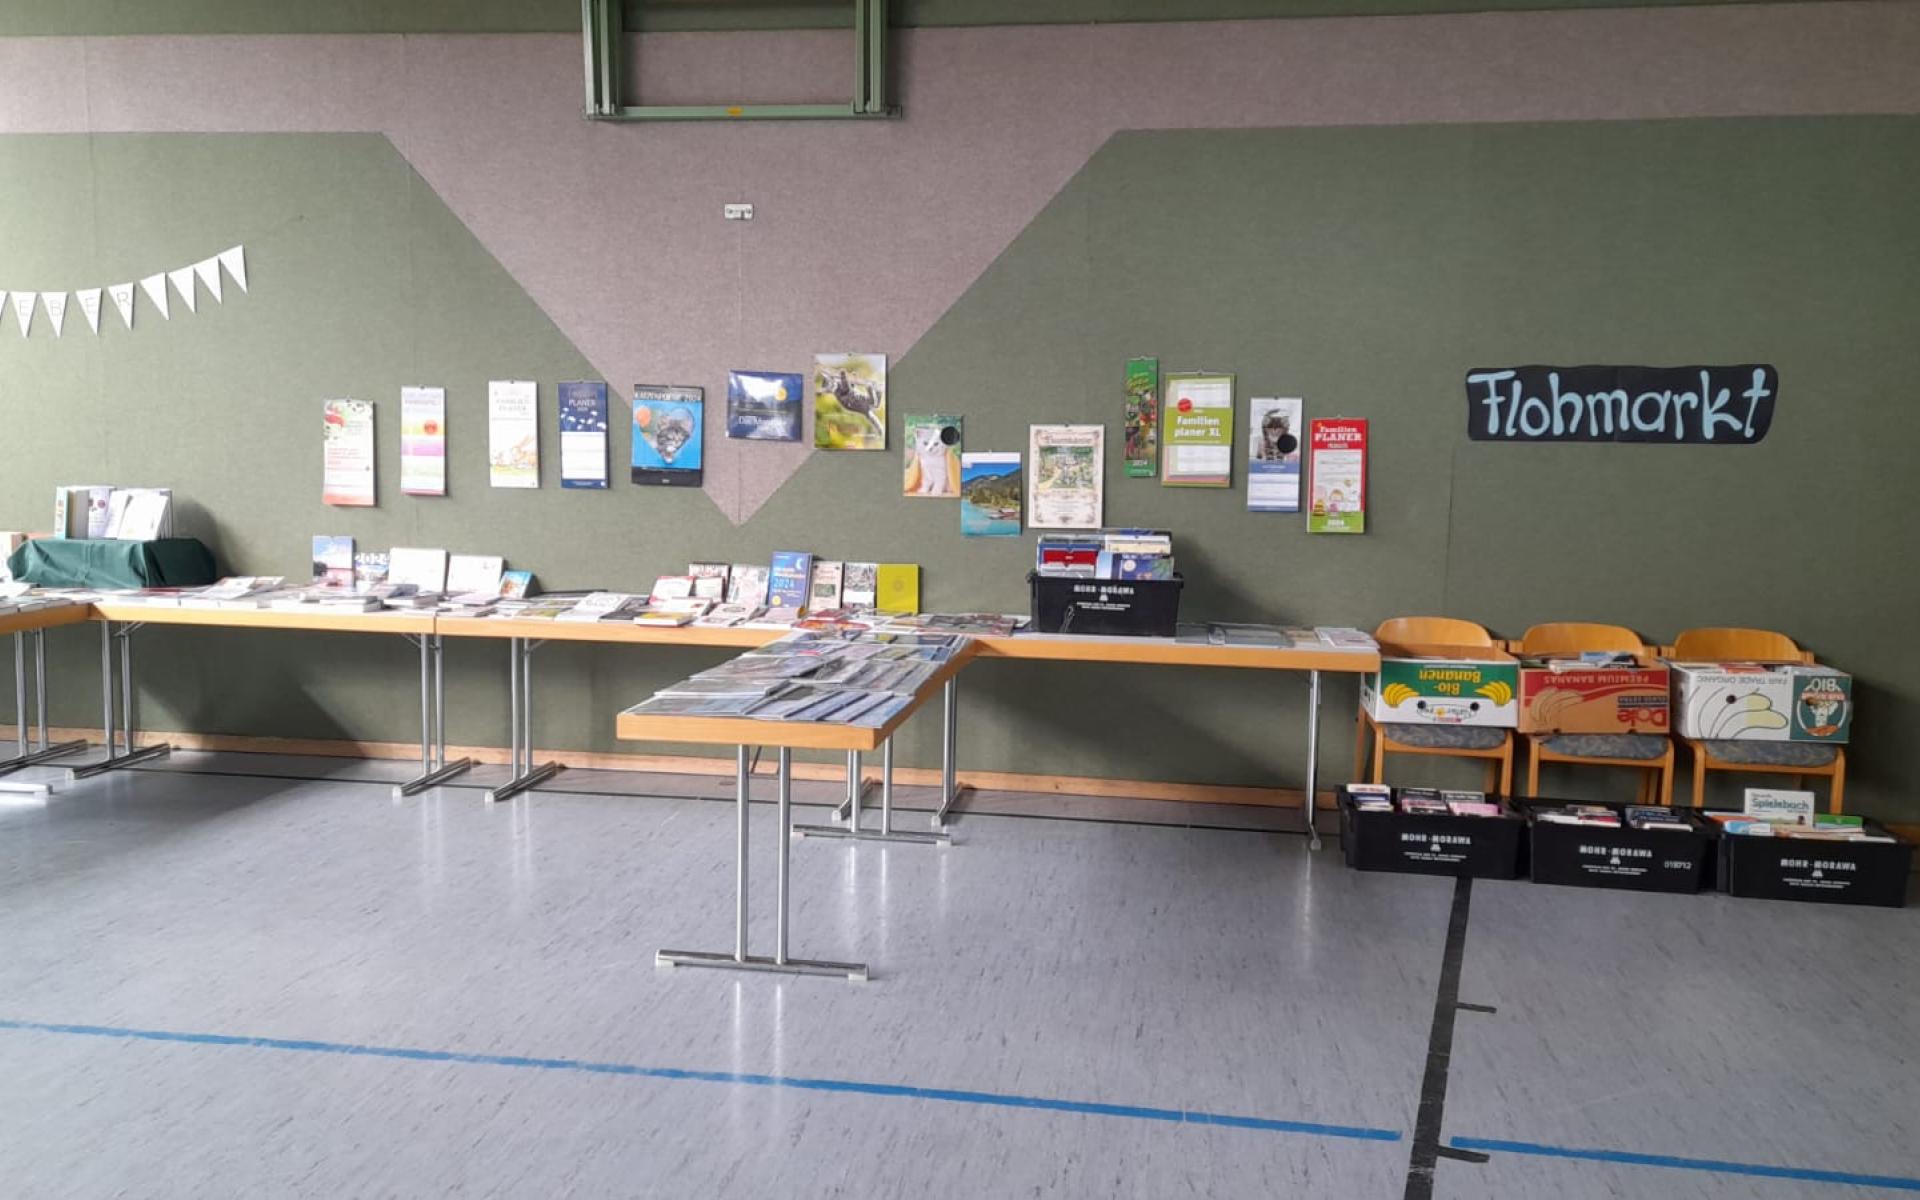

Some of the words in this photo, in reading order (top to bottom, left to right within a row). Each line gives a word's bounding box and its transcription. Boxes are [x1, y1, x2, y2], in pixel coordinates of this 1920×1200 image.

[568, 399, 596, 407] PLANER
[1467, 367, 1771, 440] Flohmarkt
[1177, 416, 1220, 425] Familien
[1174, 427, 1206, 438] planer
[1209, 427, 1222, 437] XL
[1314, 432, 1362, 442] PLANER
[1419, 669, 1482, 683] Bananen
[1544, 674, 1595, 684] BANANAS
[1597, 674, 1649, 684] PREMIUM
[1697, 675, 1737, 684] ORGANIC
[1739, 675, 1766, 684] TRADE
[1768, 676, 1787, 684] FAIR
[1433, 683, 1461, 696] Bio-
[1811, 678, 1837, 692] BIO
[1617, 707, 1667, 727] Dole
